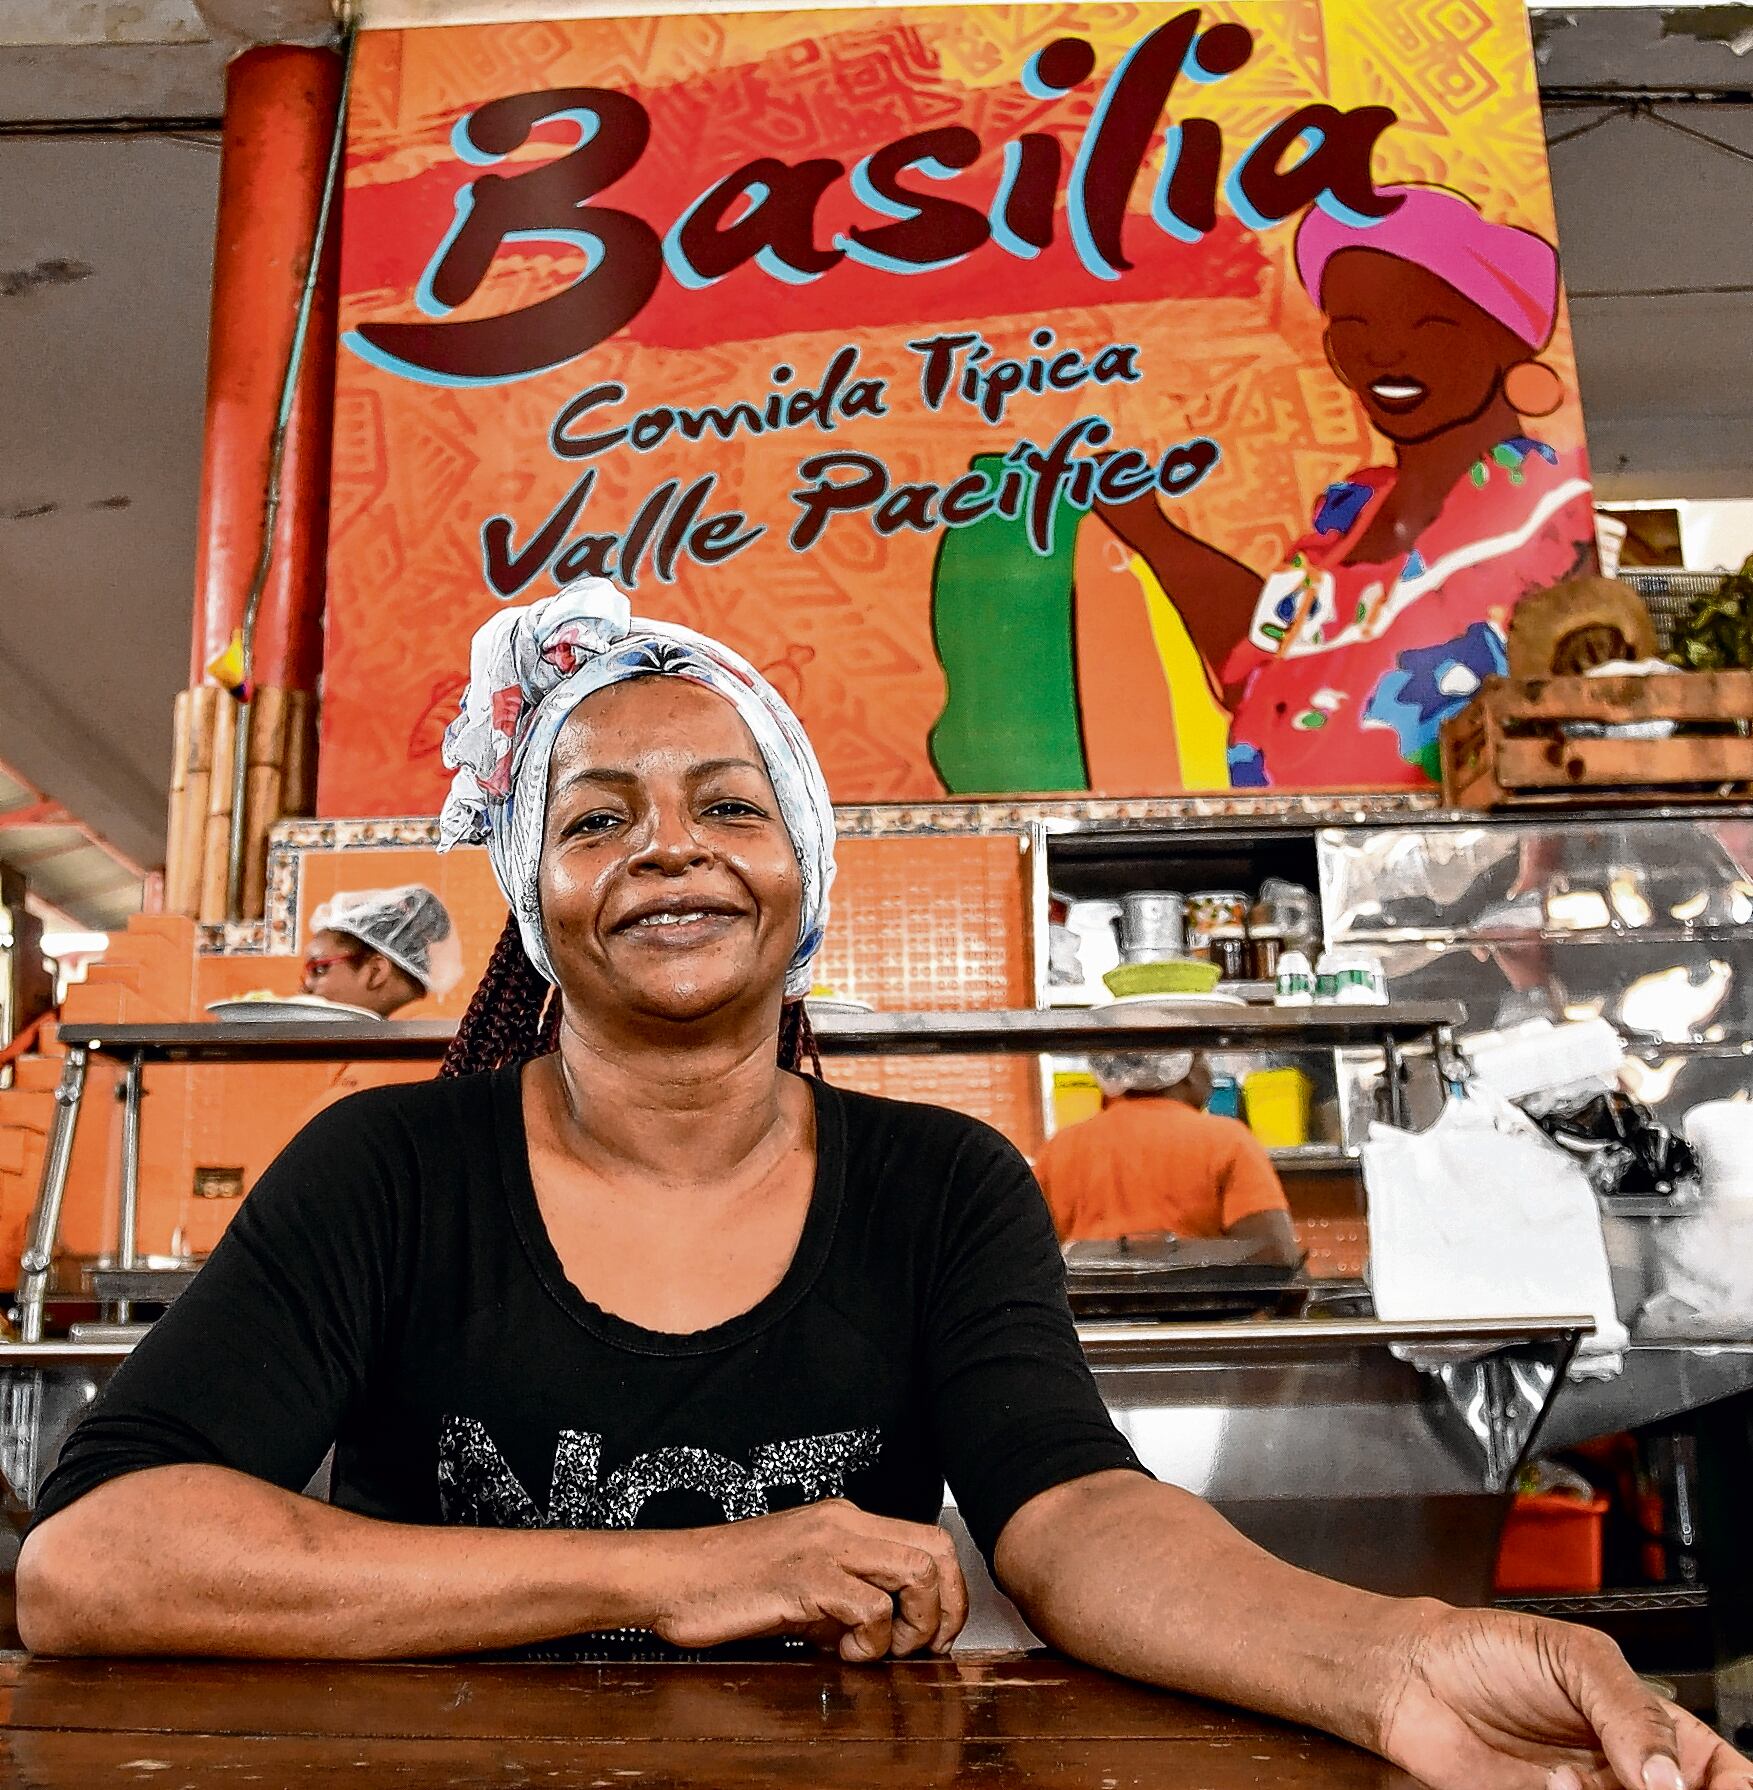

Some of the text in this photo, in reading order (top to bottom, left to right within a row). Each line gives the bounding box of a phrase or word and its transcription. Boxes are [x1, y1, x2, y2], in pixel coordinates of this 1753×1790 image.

[341, 8, 1407, 388] Basilia
[549, 327, 1142, 462] Comida Típica
[481, 415, 1221, 598] Valle Pacífico
